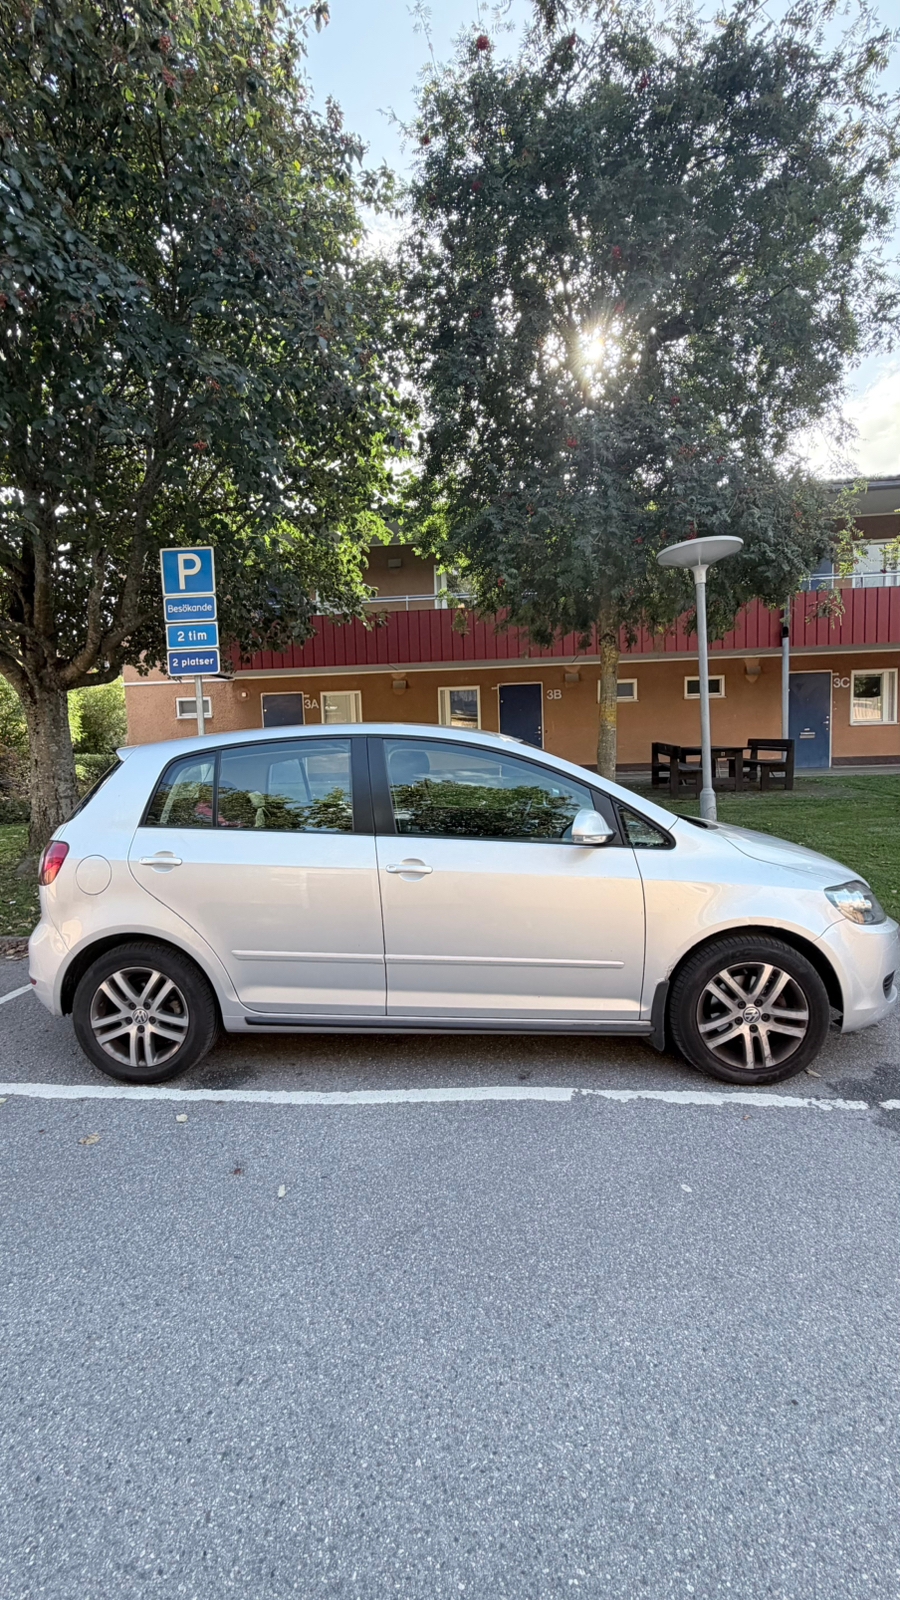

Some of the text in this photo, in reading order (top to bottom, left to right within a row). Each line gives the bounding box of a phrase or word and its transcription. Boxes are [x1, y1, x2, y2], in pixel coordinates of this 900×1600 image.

[177, 553, 202, 590] P
[167, 603, 213, 613] Besökande
[177, 630, 207, 642] 2 tim
[172, 657, 214, 668] 2 platser
[833, 677, 850, 688] 3C
[546, 689, 562, 700] 3B
[304, 699, 319, 709] 3A
